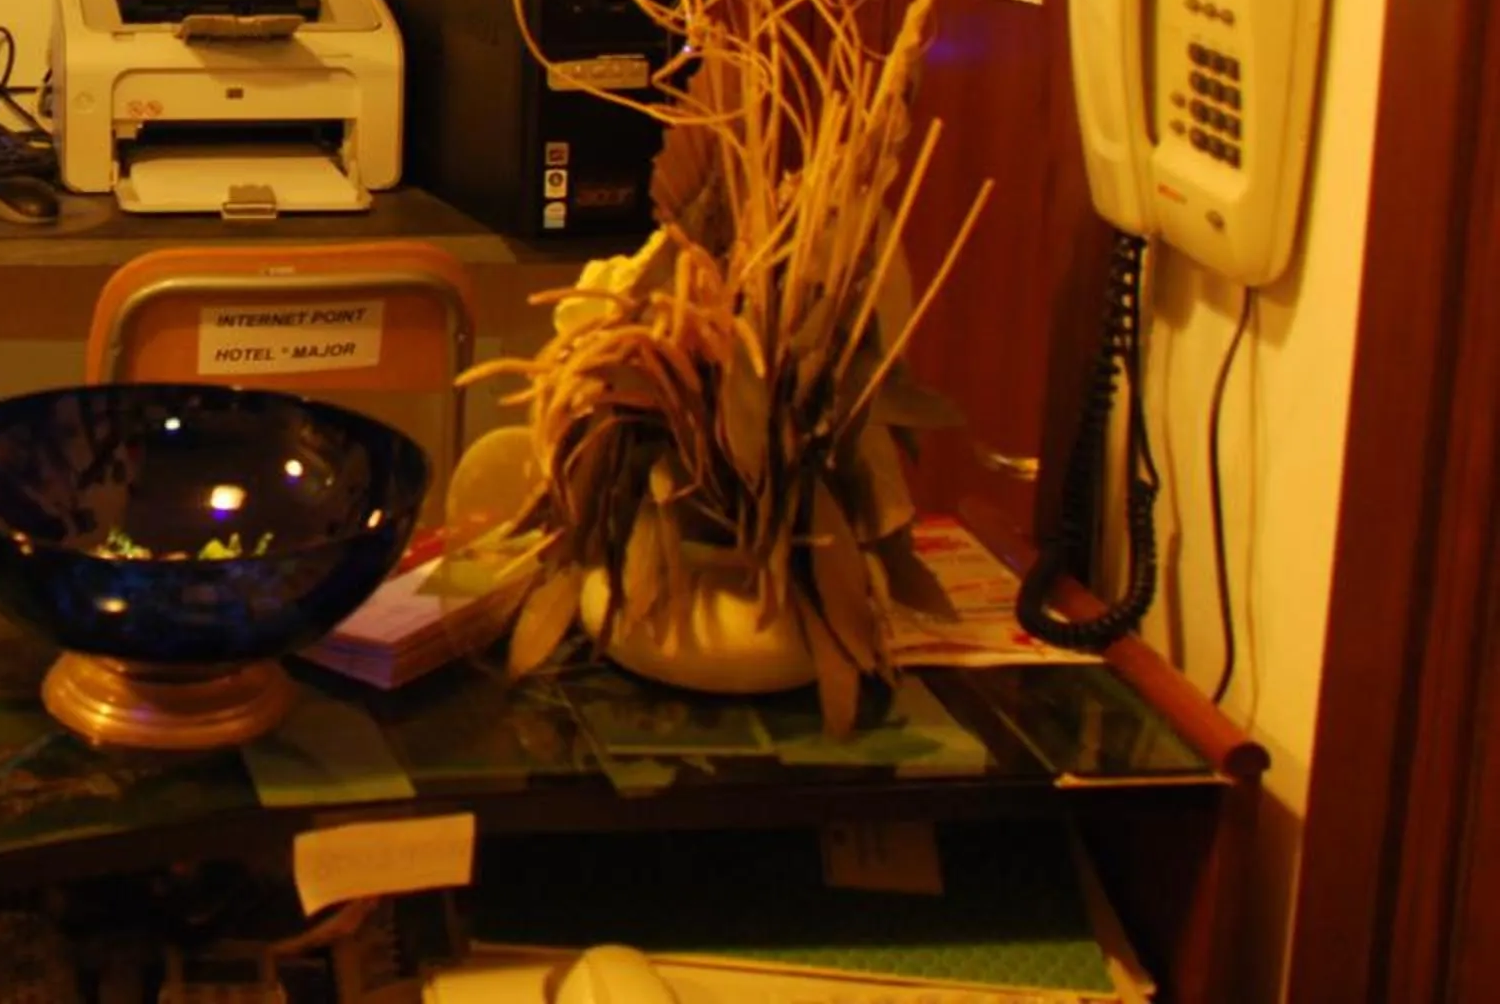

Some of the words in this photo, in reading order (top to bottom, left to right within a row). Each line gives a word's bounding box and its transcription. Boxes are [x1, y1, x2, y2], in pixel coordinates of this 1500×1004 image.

[216, 311, 310, 327] INTERNET
[311, 307, 368, 324] POINT
[214, 347, 275, 362] HOTEL
